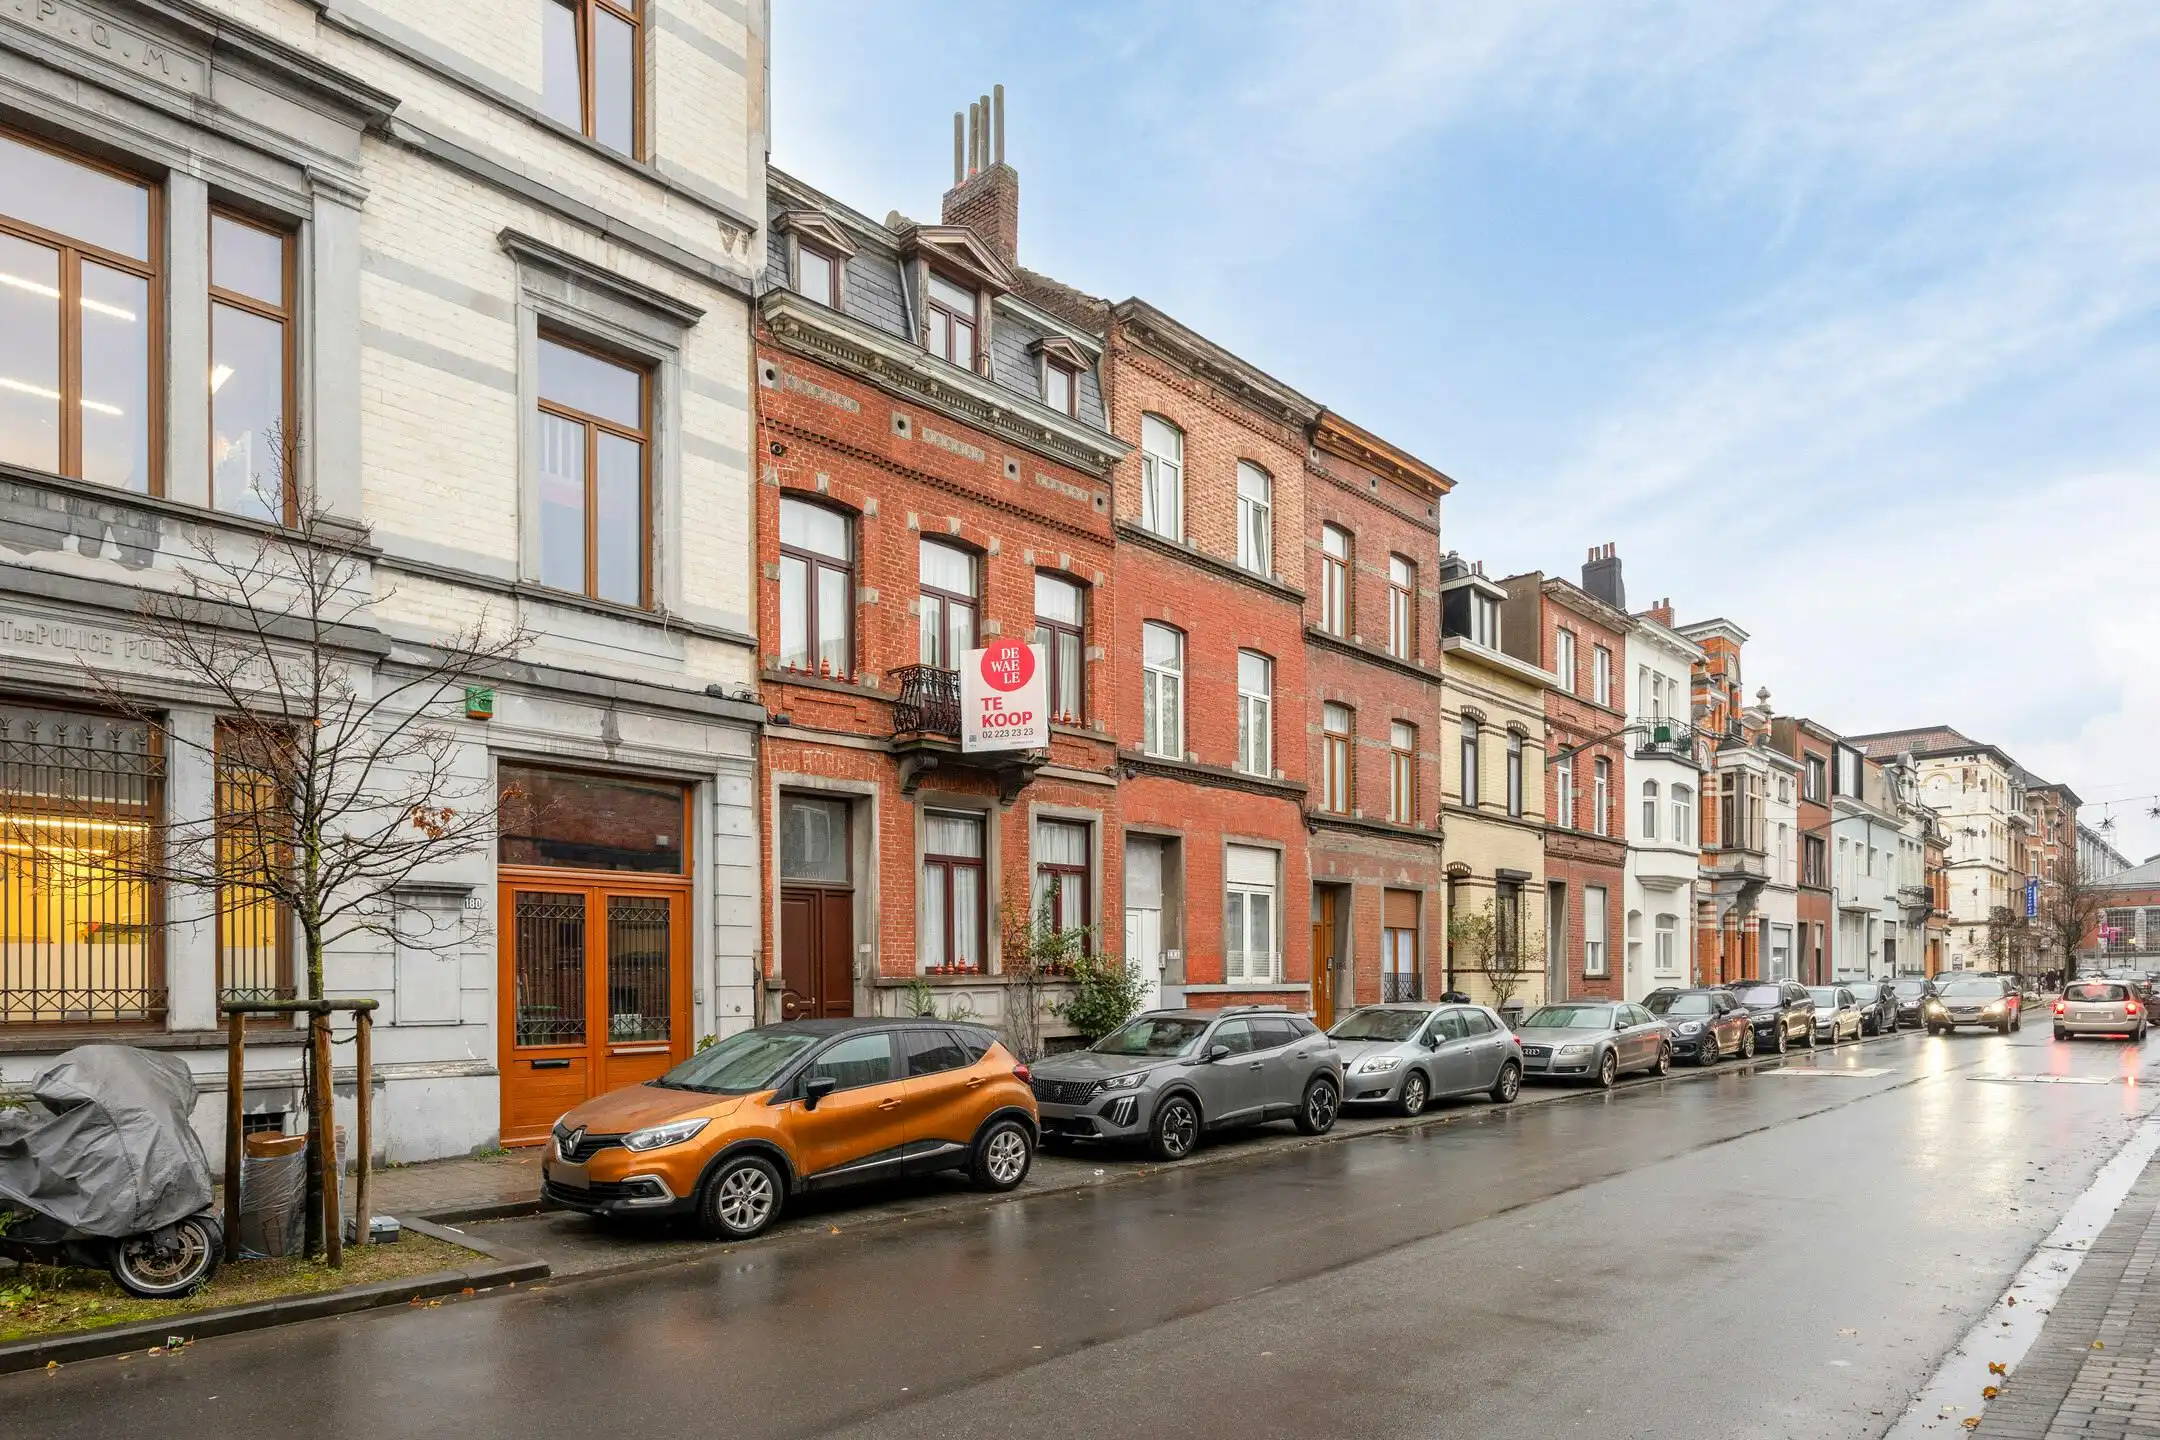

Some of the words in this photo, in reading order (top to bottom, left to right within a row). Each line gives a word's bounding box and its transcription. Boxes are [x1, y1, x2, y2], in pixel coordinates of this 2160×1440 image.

[36, 623, 113, 655] POLICE
[1000, 647, 1020, 660] DE
[991, 659, 1020, 673] WAE
[1003, 672, 1020, 684] LE
[980, 696, 1003, 711] TE
[981, 711, 1033, 728] KOOP
[982, 730, 993, 739] 02
[994, 729, 1010, 738] 223
[1011, 728, 1022, 737] 23
[1023, 727, 1034, 736] 23
[465, 898, 481, 909] 180
